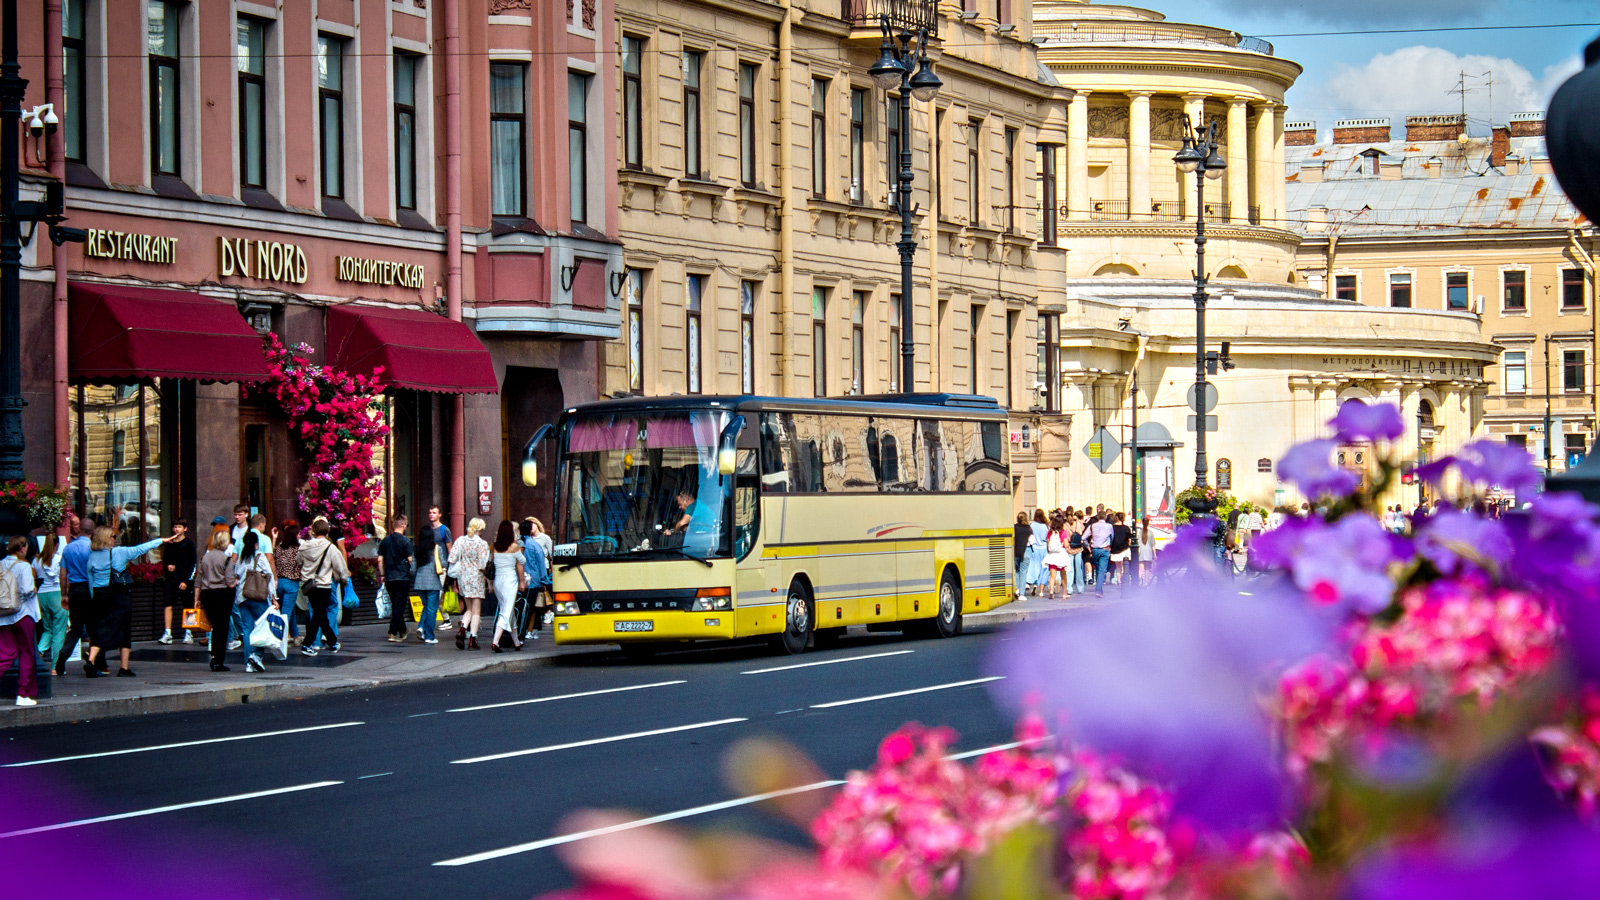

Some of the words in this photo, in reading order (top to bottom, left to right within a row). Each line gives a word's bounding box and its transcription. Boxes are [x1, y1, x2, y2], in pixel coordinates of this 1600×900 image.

[87, 228, 179, 264] RESTAURANT
[221, 235, 249, 278] DU
[257, 239, 308, 284] NORD
[339, 255, 425, 289] КОНДИТЕРСКАЯ
[1322, 357, 1401, 366] МЕТРОПОЛИТЕН
[1403, 359, 1471, 376] ПЛОЩАДЬ
[613, 601, 677, 609] SETRA
